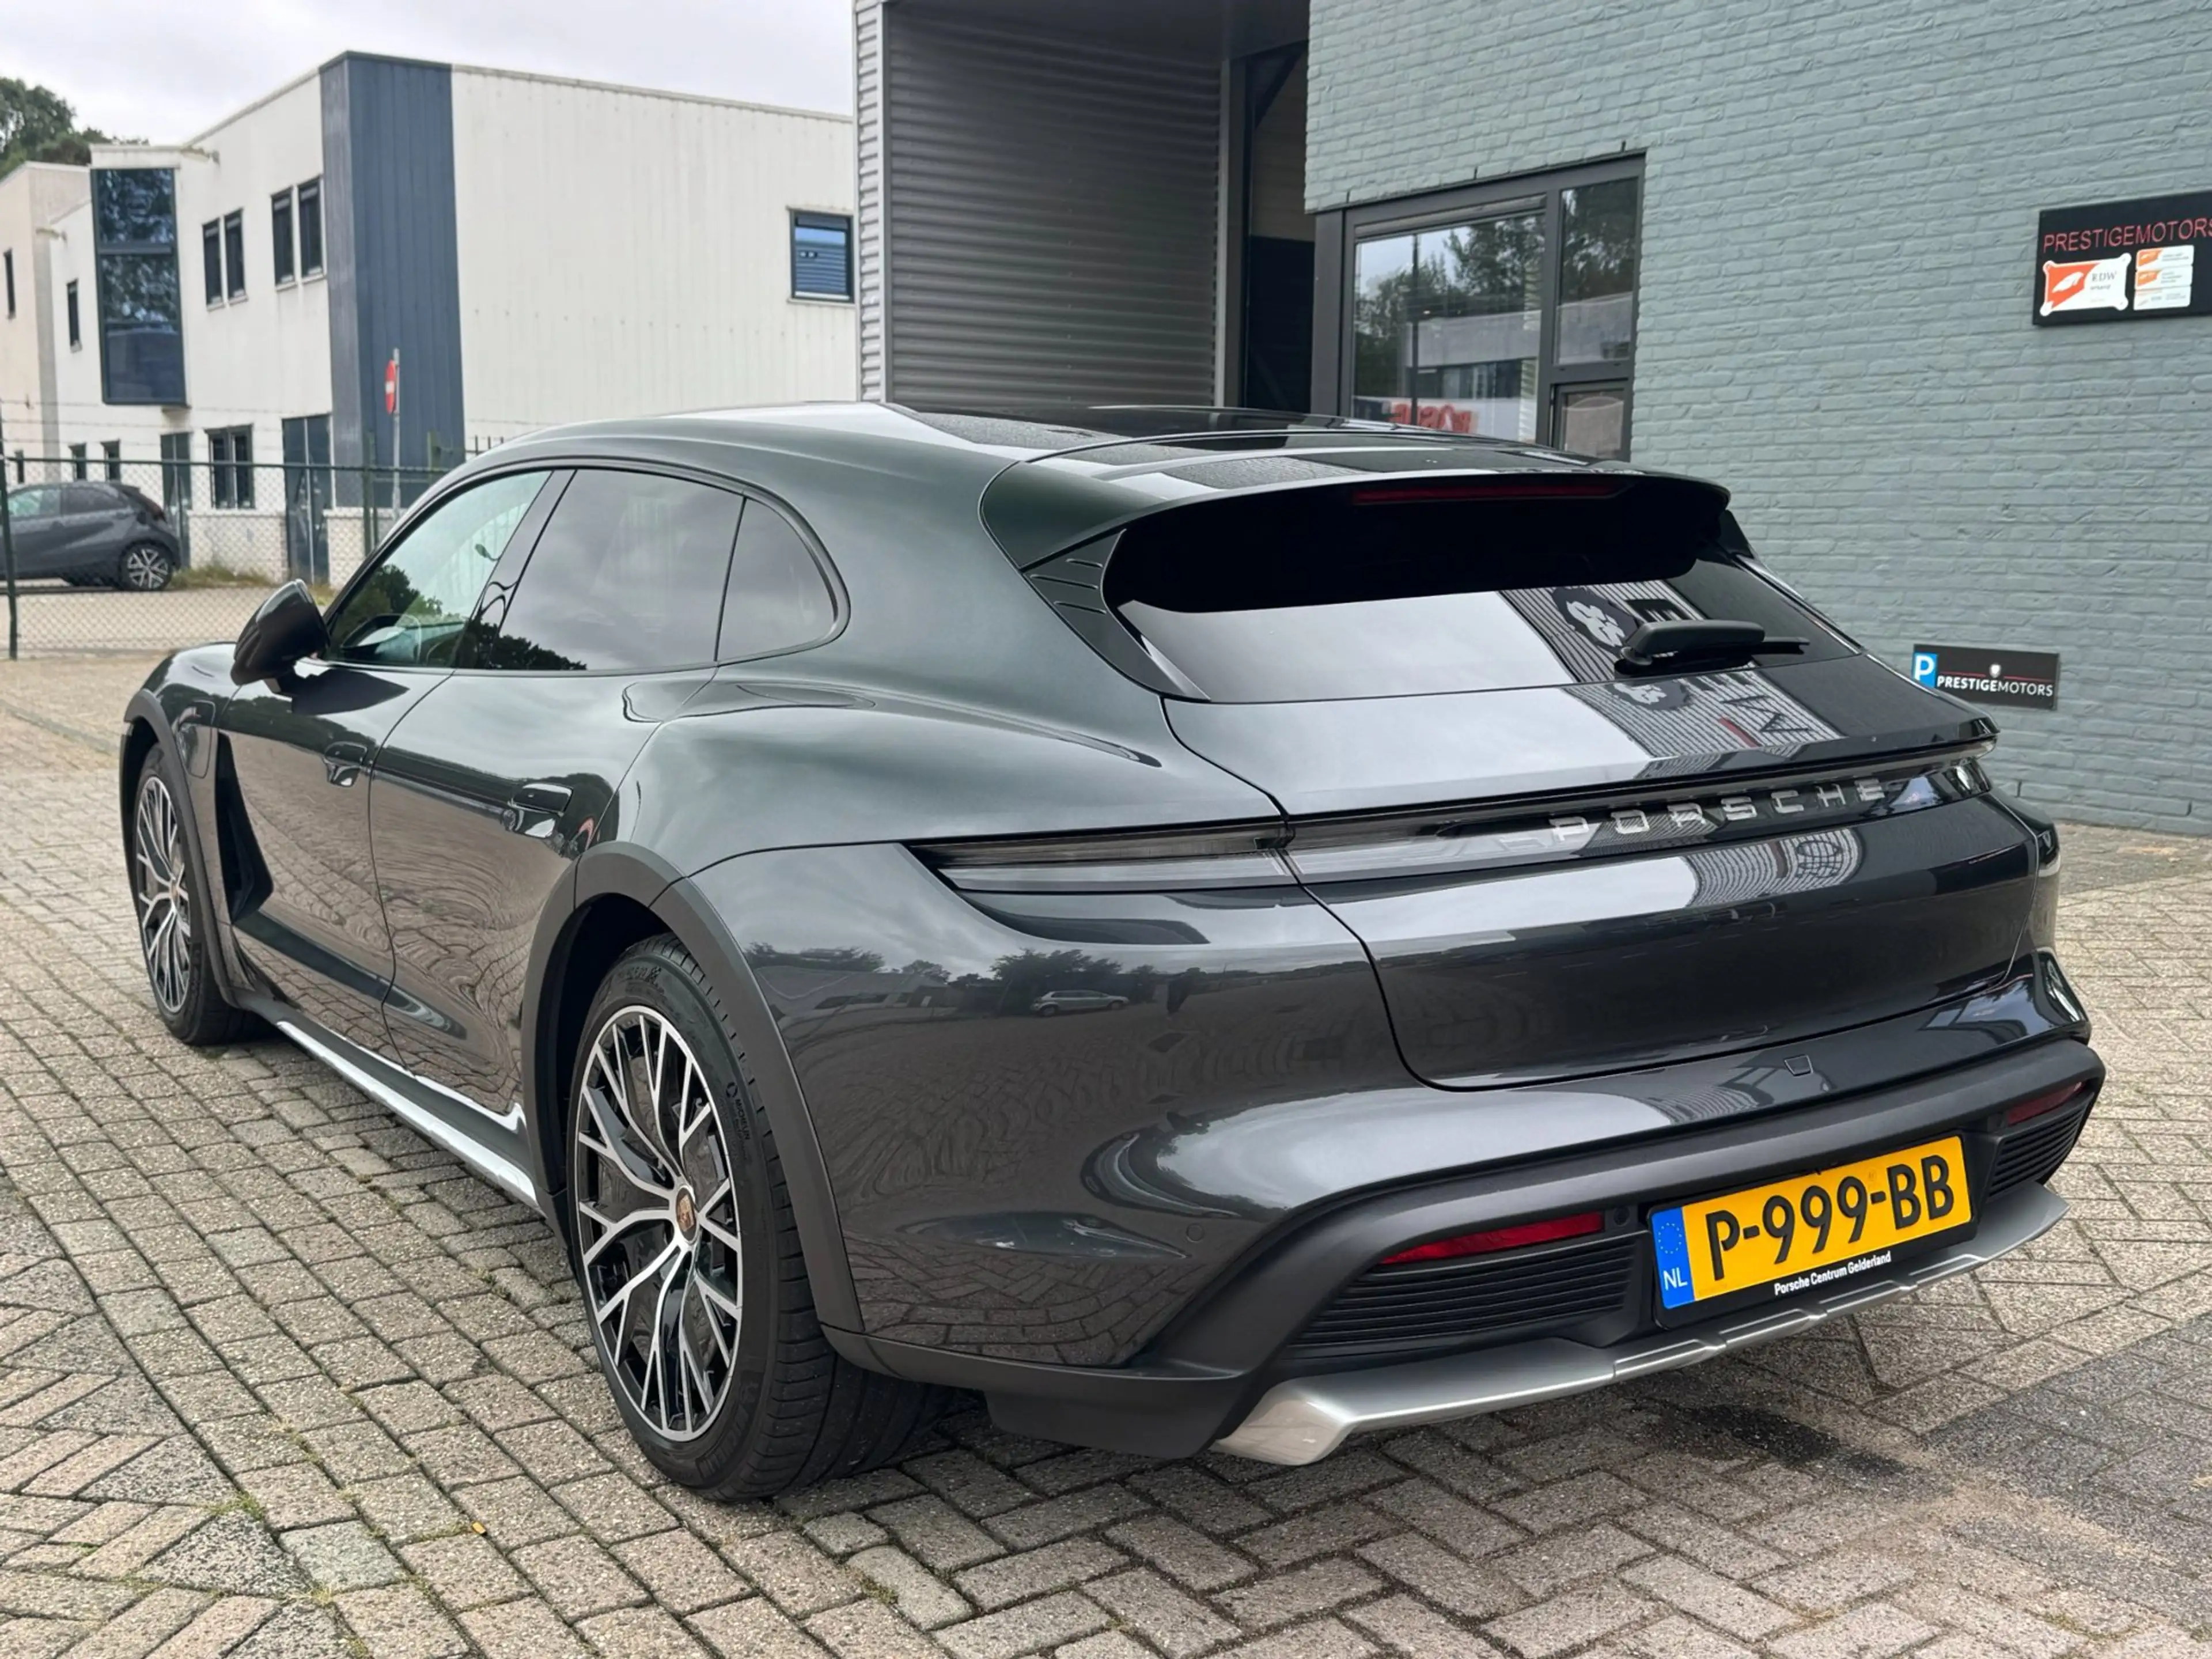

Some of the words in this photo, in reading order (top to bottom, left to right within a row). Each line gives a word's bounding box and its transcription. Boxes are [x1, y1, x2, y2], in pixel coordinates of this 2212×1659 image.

[1915, 655, 1935, 681] P
[1937, 675, 2053, 697] PRESTIGEMOTORS
[1548, 778, 1885, 842] PORSCHE
[1706, 1154, 1955, 1281] P-999-BB
[1663, 1267, 1688, 1291] NL
[1774, 1276, 1809, 1296] Porsche
[1810, 1266, 1847, 1285] Centrum
[1848, 1250, 1892, 1273] Gelderland
